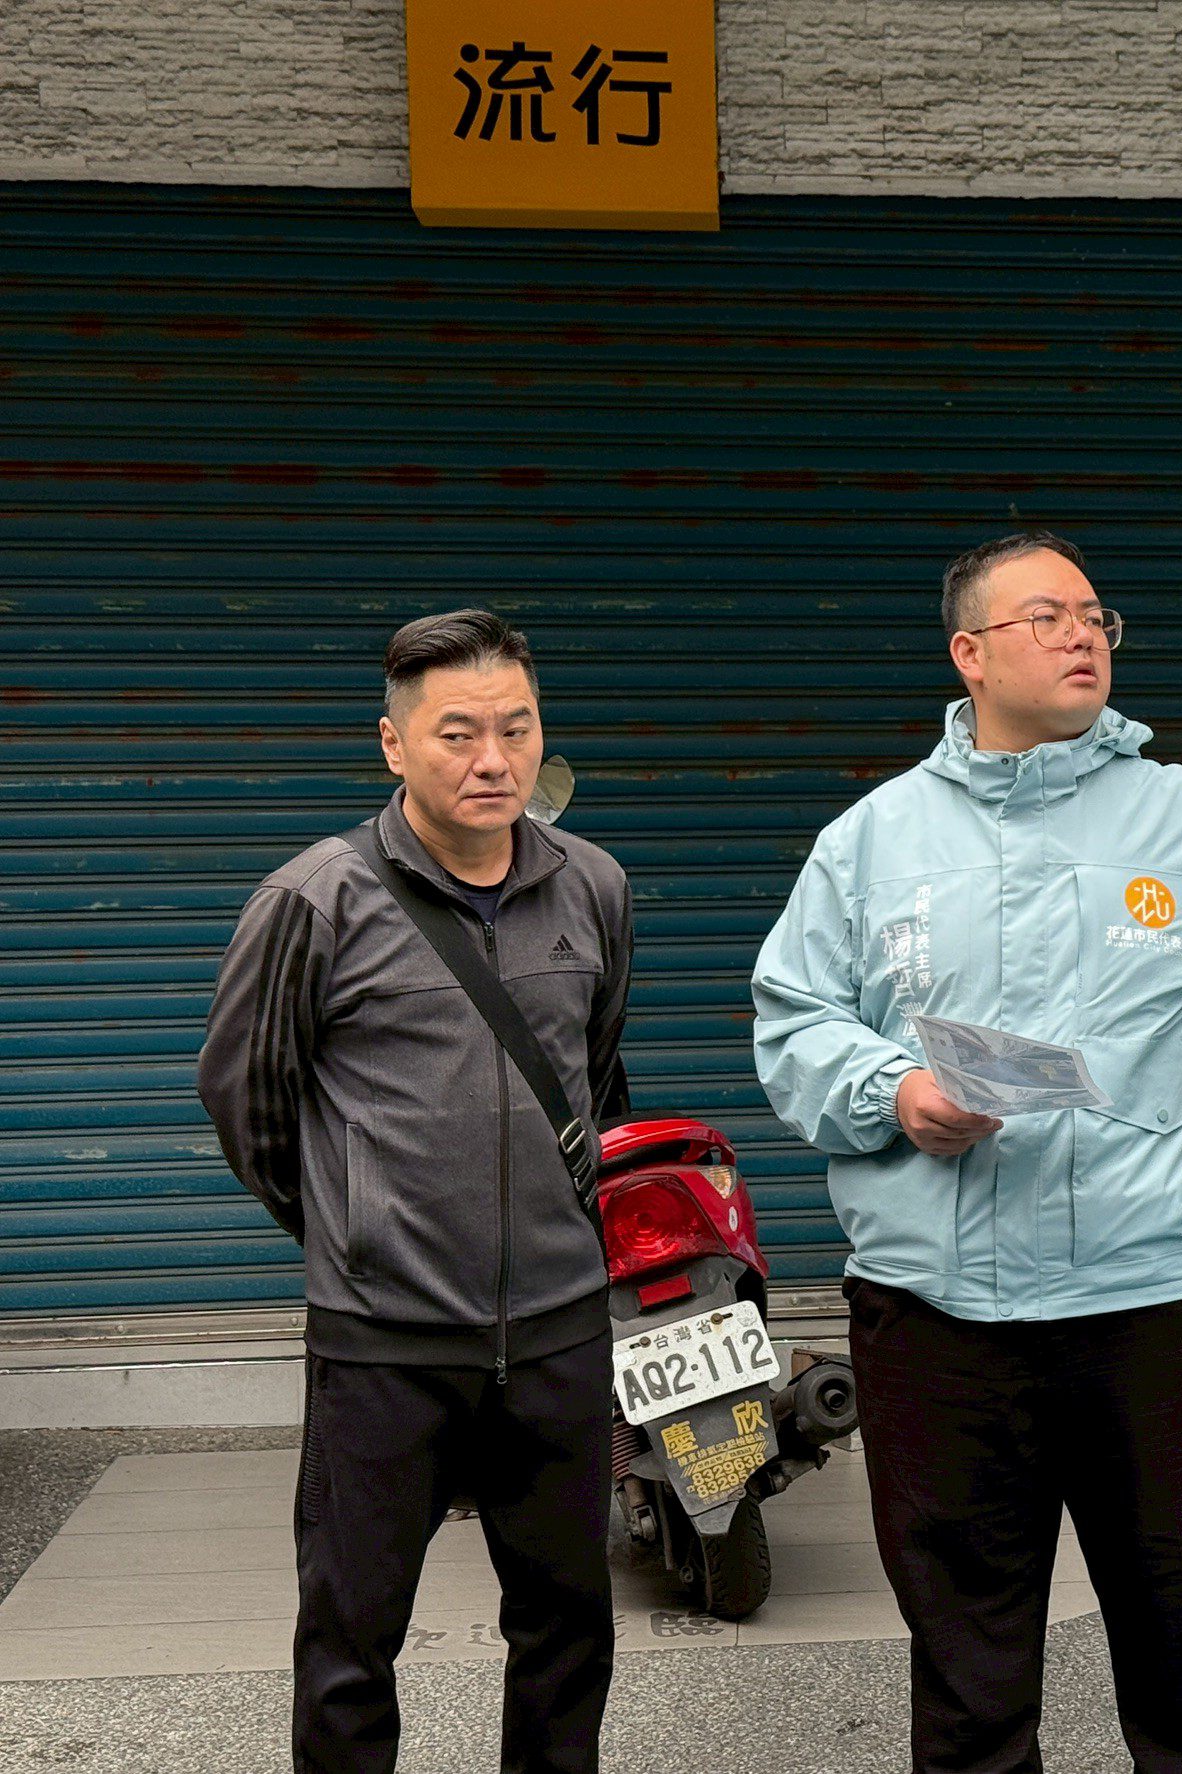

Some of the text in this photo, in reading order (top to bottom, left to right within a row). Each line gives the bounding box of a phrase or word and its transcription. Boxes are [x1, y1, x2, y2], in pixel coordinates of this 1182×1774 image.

[453, 41, 672, 146] 流行
[914, 884, 932, 988] 市民代表主席
[653, 1319, 713, 1350] 台灣省
[692, 1453, 766, 1486] 8329638
